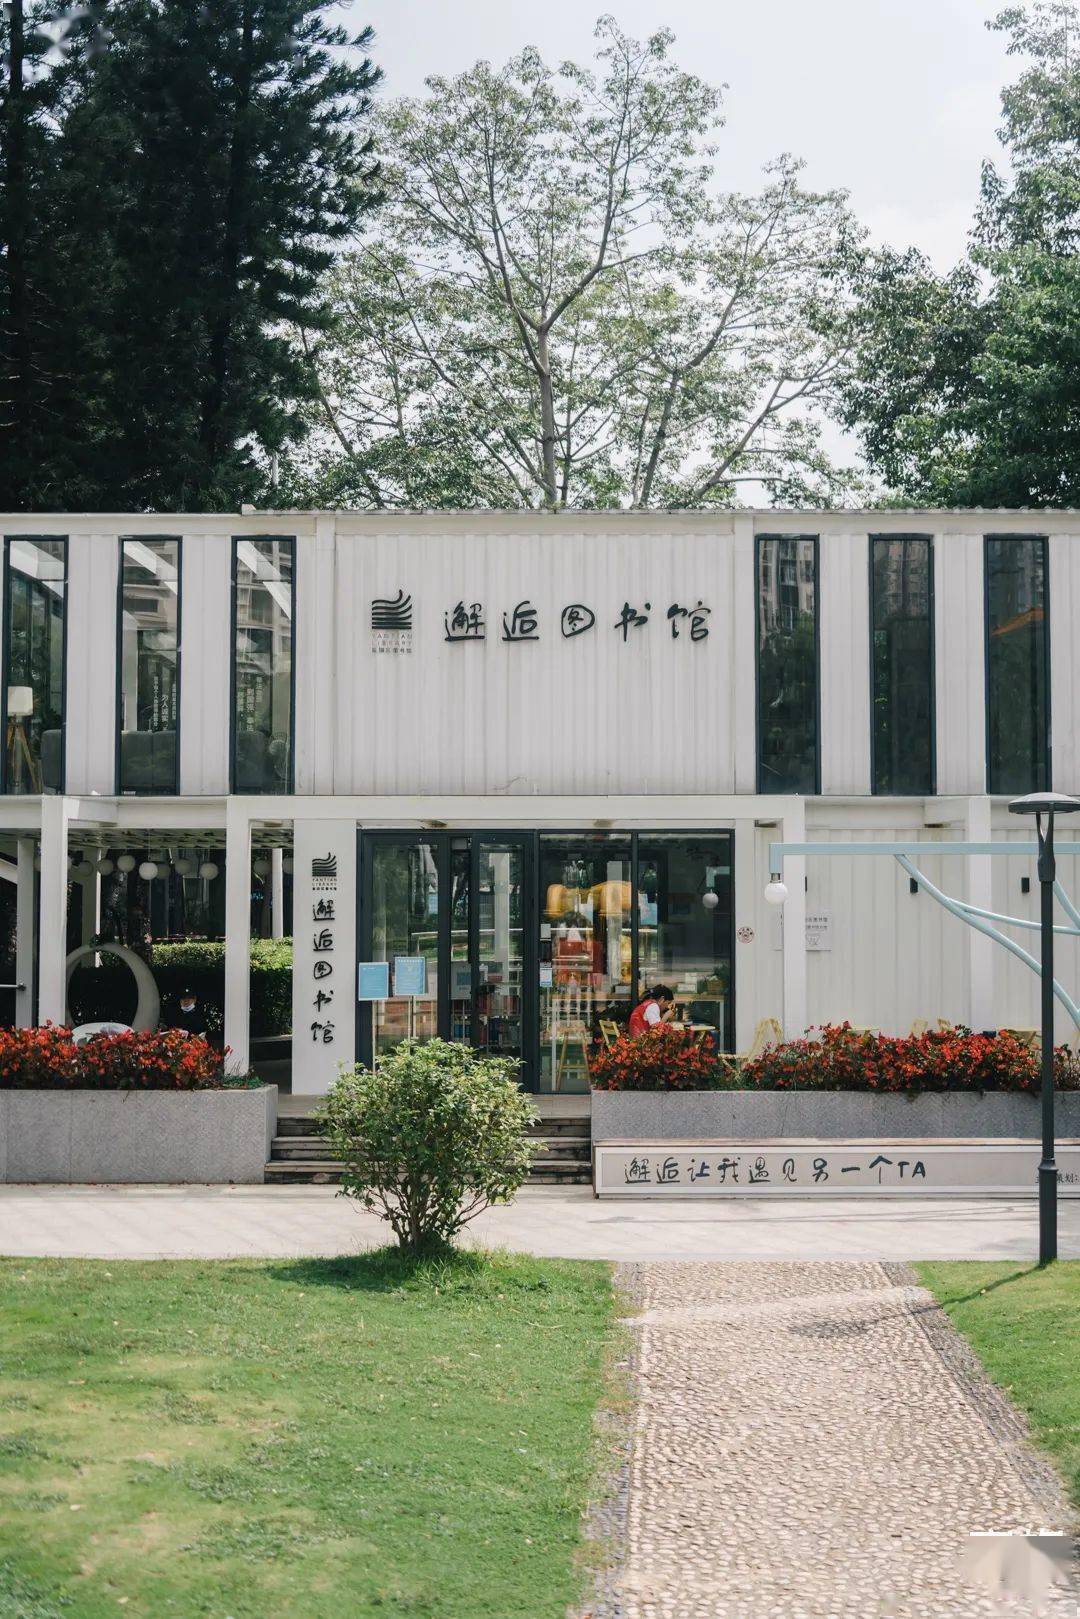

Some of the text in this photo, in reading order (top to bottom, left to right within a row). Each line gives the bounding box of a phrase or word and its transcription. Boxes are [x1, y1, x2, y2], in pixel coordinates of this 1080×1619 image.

[444, 600, 712, 642] 邂逅图书馆
[310, 898, 336, 1044] 邂逅图书馆
